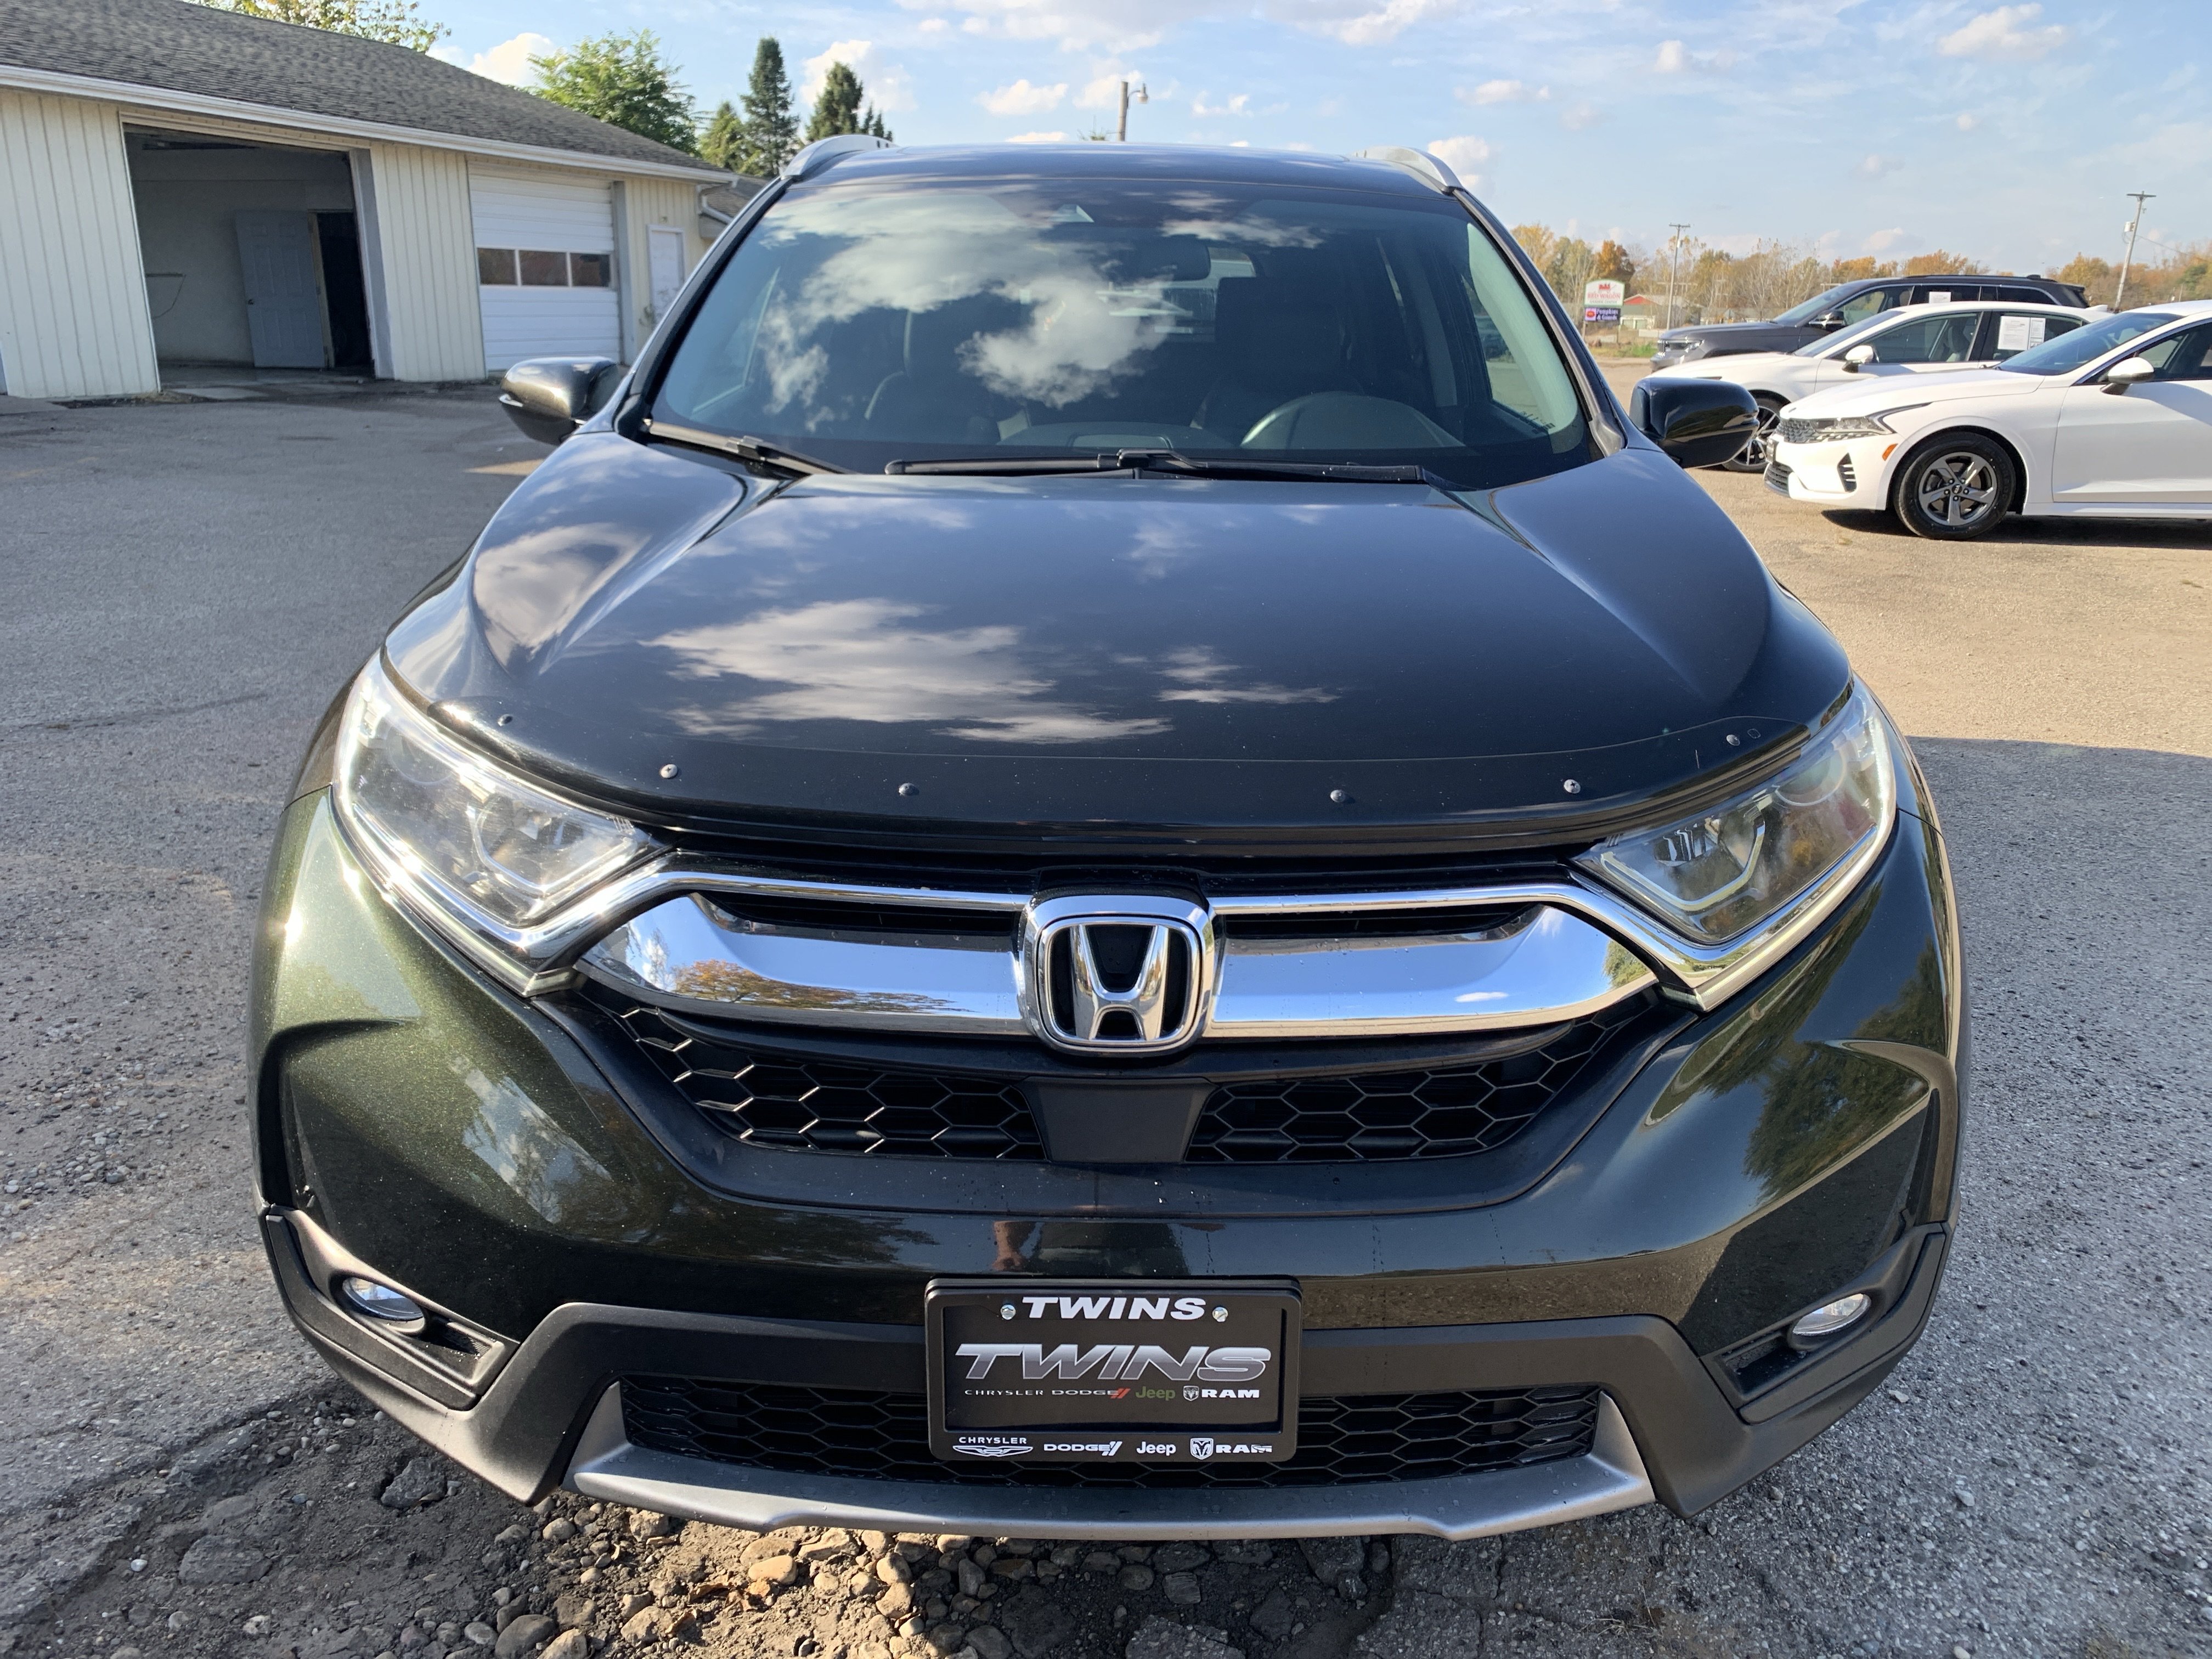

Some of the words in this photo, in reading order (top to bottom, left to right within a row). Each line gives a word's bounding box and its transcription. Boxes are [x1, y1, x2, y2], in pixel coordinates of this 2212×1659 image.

[1022, 1297, 1206, 1320] TWINS
[955, 1343, 1272, 1382] TWINS
[1136, 1386, 1176, 1400] Jeep
[1201, 1389, 1260, 1398] RAM
[1137, 1441, 1177, 1456] Jeep
